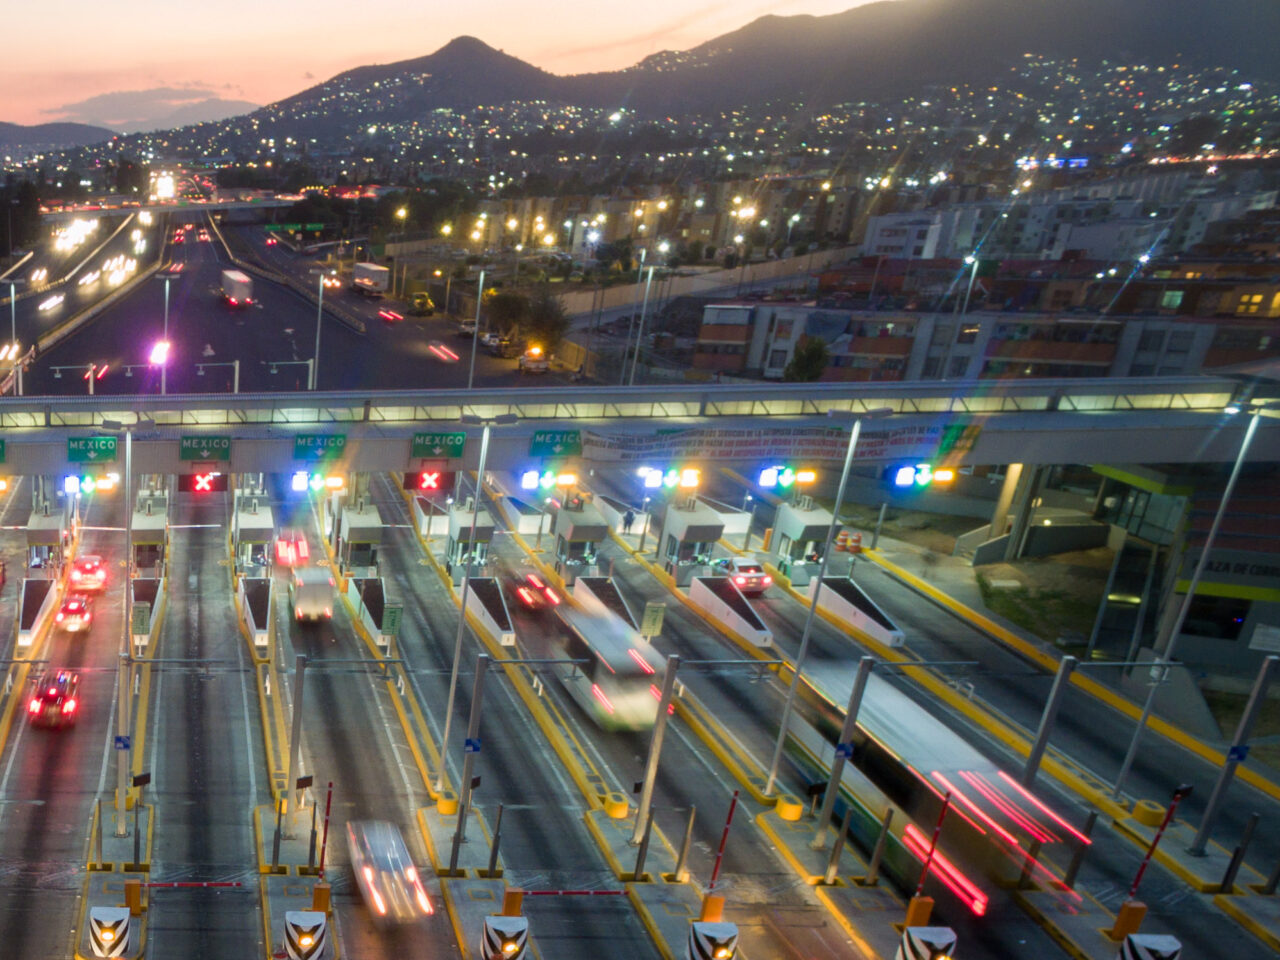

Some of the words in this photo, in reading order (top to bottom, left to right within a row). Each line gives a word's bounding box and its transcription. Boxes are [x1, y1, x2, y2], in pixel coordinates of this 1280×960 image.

[70, 440, 115, 450] MEXICO
[182, 439, 229, 448] MEXICO
[297, 437, 344, 446] MEXICO
[415, 436, 463, 445] MEXICO
